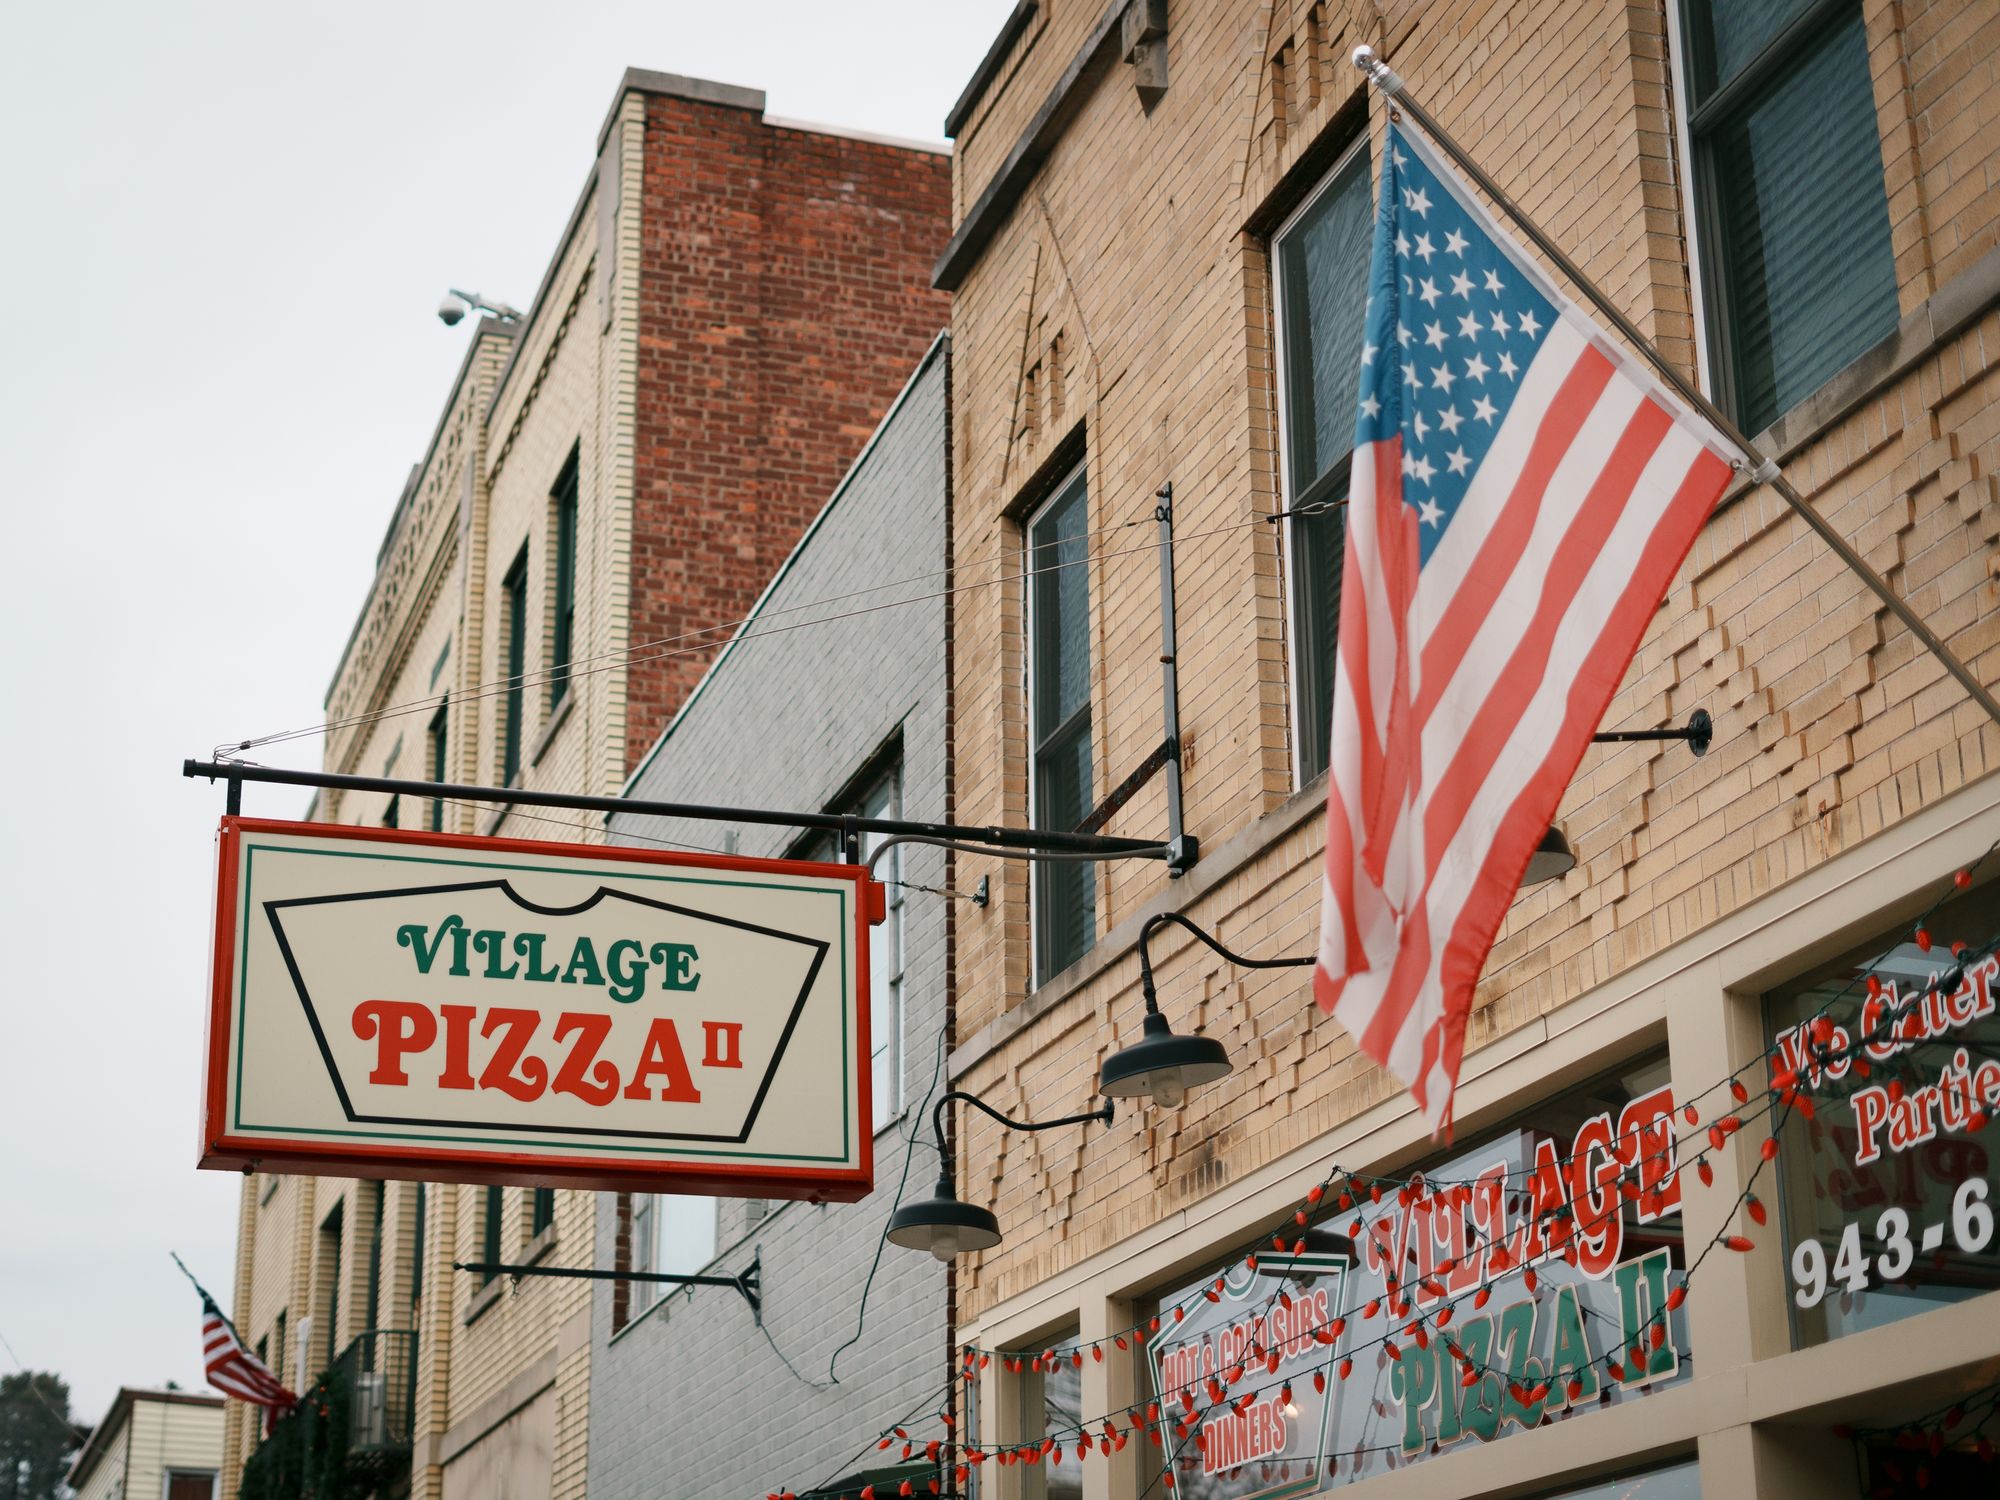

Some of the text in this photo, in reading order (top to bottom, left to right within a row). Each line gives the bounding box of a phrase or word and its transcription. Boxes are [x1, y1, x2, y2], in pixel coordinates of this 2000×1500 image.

[397, 915, 701, 1003] VILLAGE
[352, 999, 743, 1106] PIZZA II
[1366, 1085, 1682, 1320] VILLAGE
[1792, 1178, 1994, 1308] 943-6
[1163, 1288, 1329, 1407] HOT & COLD SUBS
[1389, 1246, 1679, 1457] PIZZA II
[1203, 1396, 1287, 1476] DINNERS
